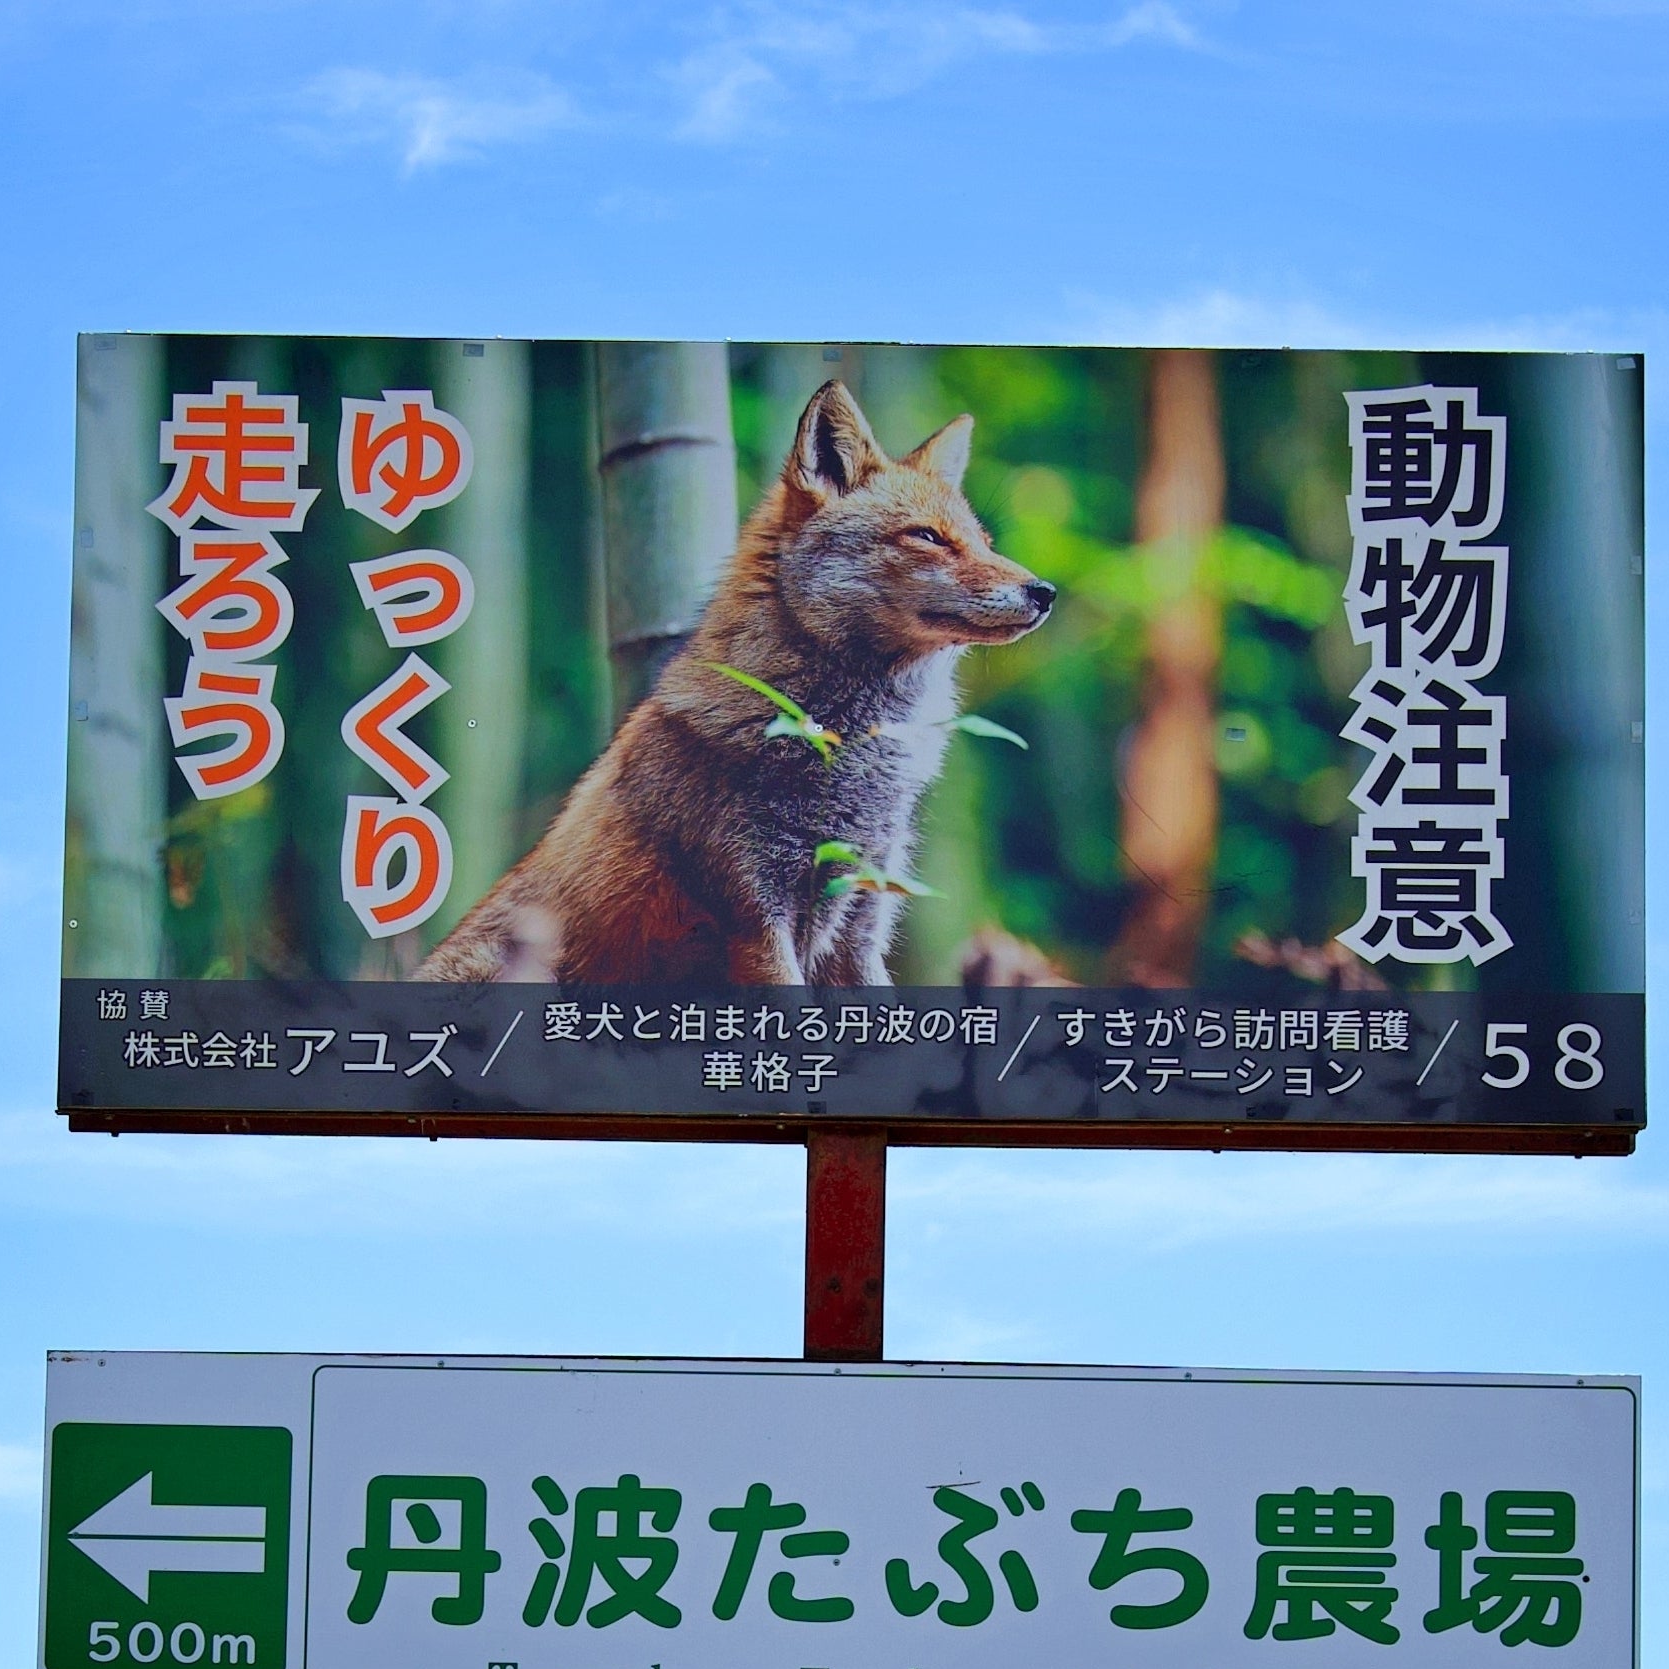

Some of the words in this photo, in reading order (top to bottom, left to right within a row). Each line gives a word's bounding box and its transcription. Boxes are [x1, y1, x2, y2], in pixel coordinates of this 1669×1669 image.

[147, 380, 320, 800] 走ろう
[338, 389, 474, 939] ゆっくり
[1338, 384, 1515, 968] 動物注意
[97, 989, 169, 1020] 協賛
[543, 1002, 998, 1045] 愛犬と泊まれる丹波の宿
[124, 1025, 458, 1079] 株式会社アユズ
[1056, 1008, 1410, 1053] すきがら訪問看護
[703, 1053, 837, 1093] 華格子
[1100, 1057, 1363, 1096] ステーション
[1480, 1022, 1604, 1090] 58
[345, 1472, 1586, 1648] 丹波たぶち農場
[86, 1621, 258, 1668] 500m
